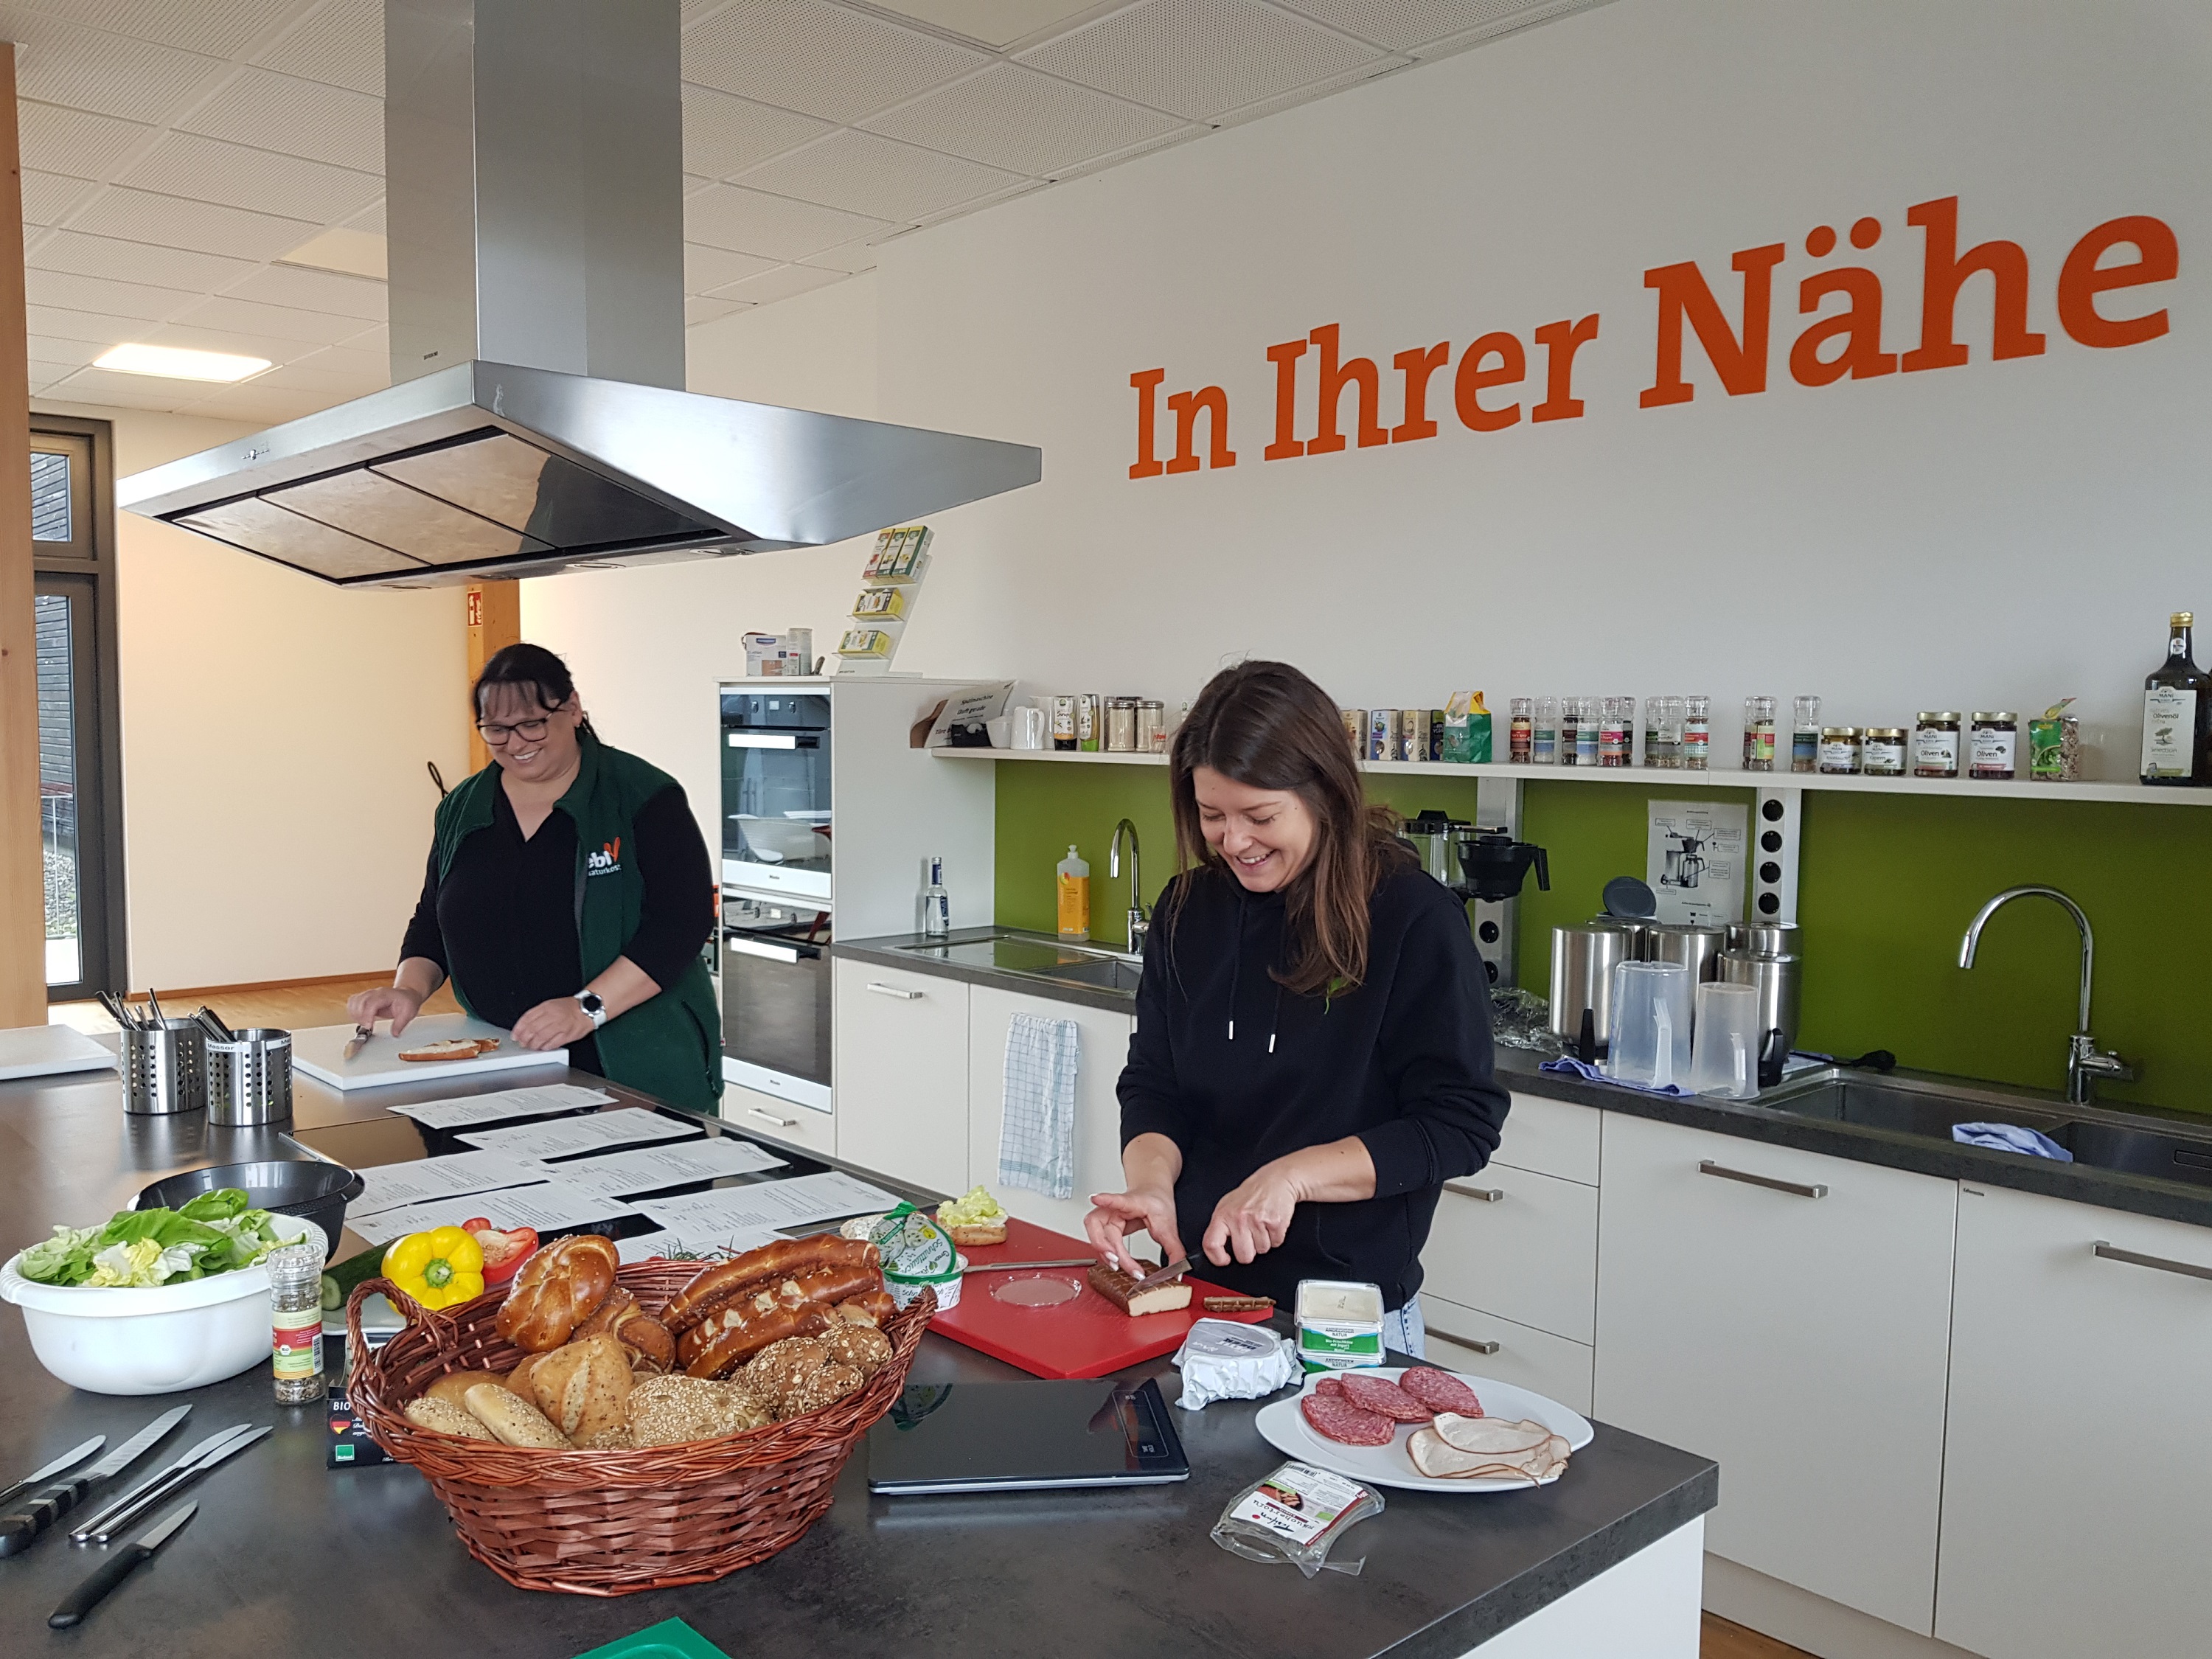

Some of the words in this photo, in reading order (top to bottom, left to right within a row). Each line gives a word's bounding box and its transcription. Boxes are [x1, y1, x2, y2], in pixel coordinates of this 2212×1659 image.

[1130, 369, 1235, 479] In
[1265, 314, 1599, 460] Ihrer
[1641, 197, 2177, 408] Nähe
[333, 1402, 351, 1411] BIO
[1258, 1512, 1294, 1532] Taifun
